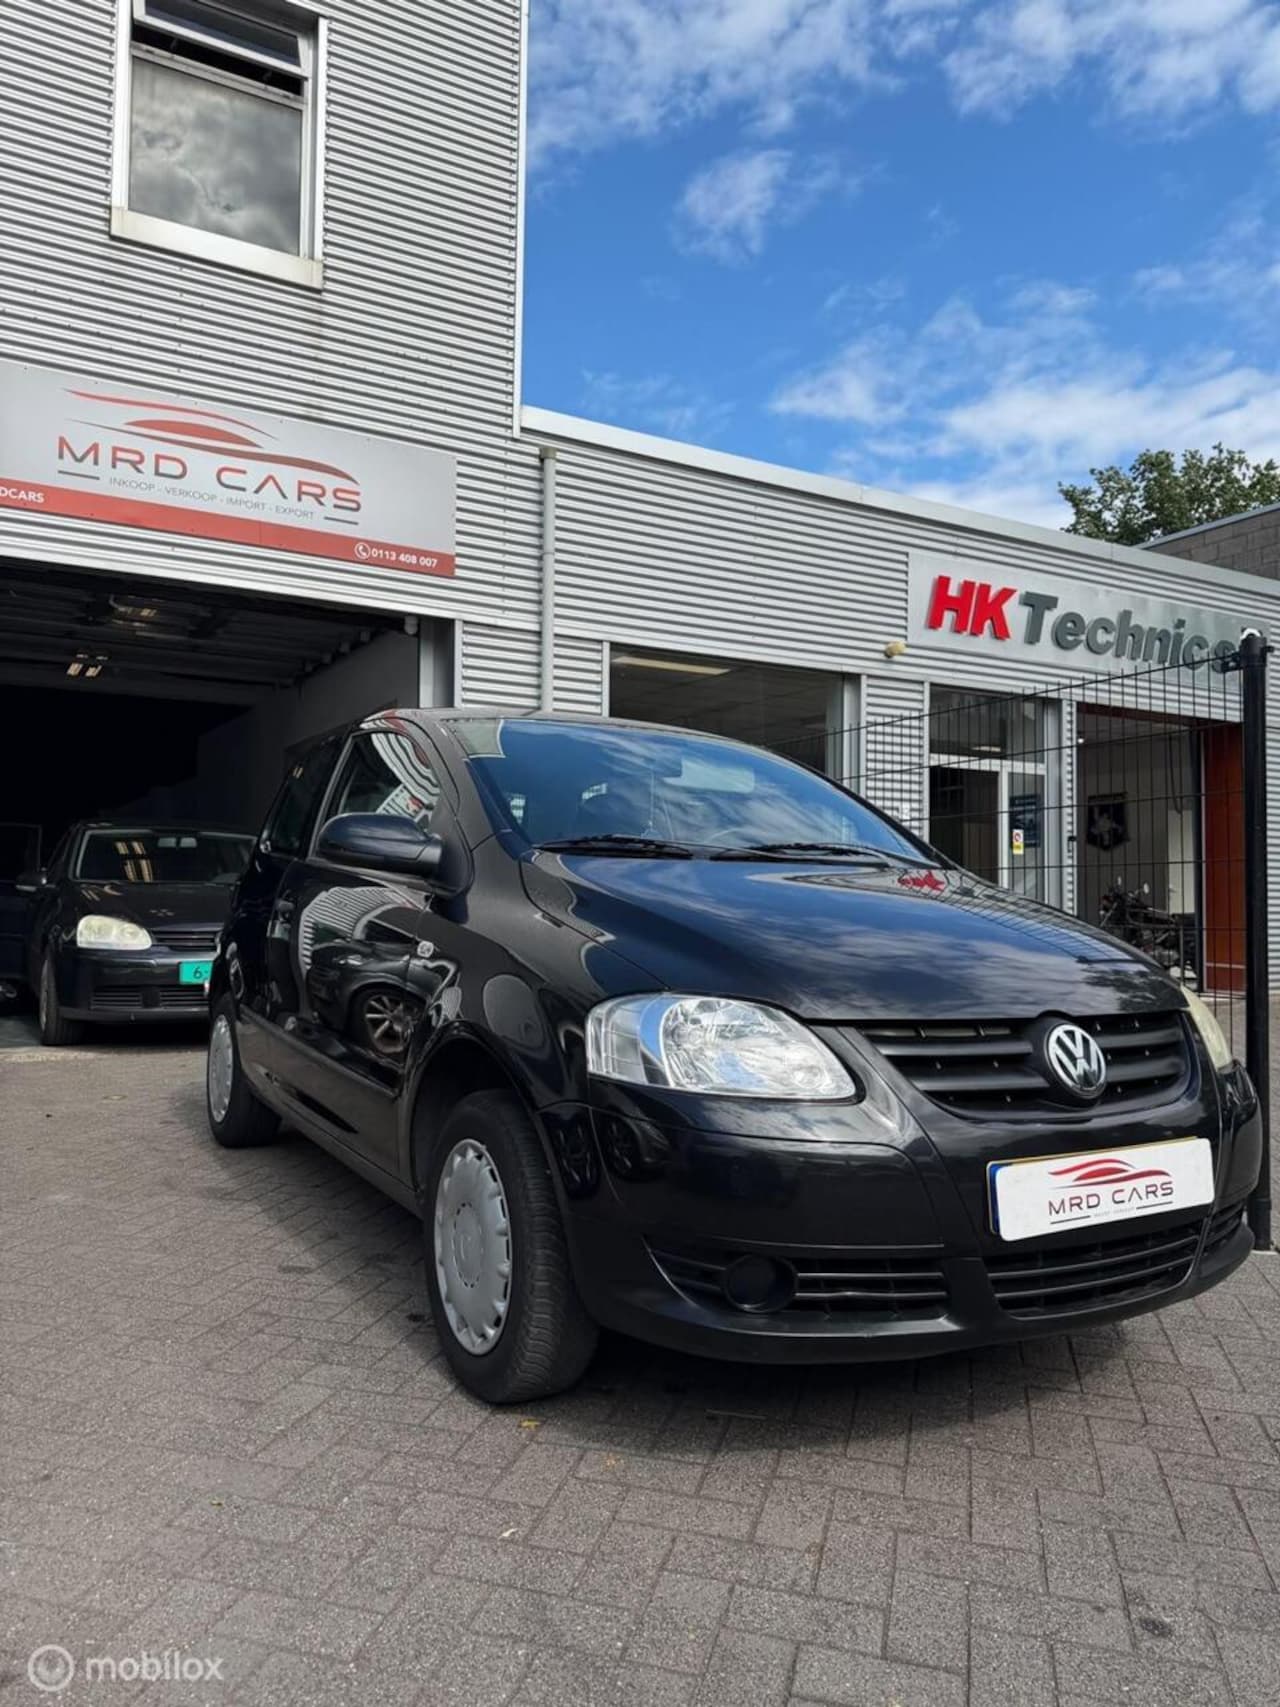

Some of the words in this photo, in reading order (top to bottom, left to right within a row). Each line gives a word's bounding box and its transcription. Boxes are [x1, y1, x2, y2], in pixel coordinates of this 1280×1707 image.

[57, 435, 188, 480] MRD
[215, 466, 362, 513] CARS
[109, 476, 156, 492] INKOOP
[164, 486, 218, 503] VERKOOP
[225, 497, 267, 512] IMPORT
[275, 505, 314, 520] EXPORT
[371, 547, 397, 561] 0113
[398, 552, 418, 565] 408
[419, 556, 438, 568] 007
[1048, 1193, 1101, 1216] MRD
[1111, 1181, 1174, 1205] CARS
